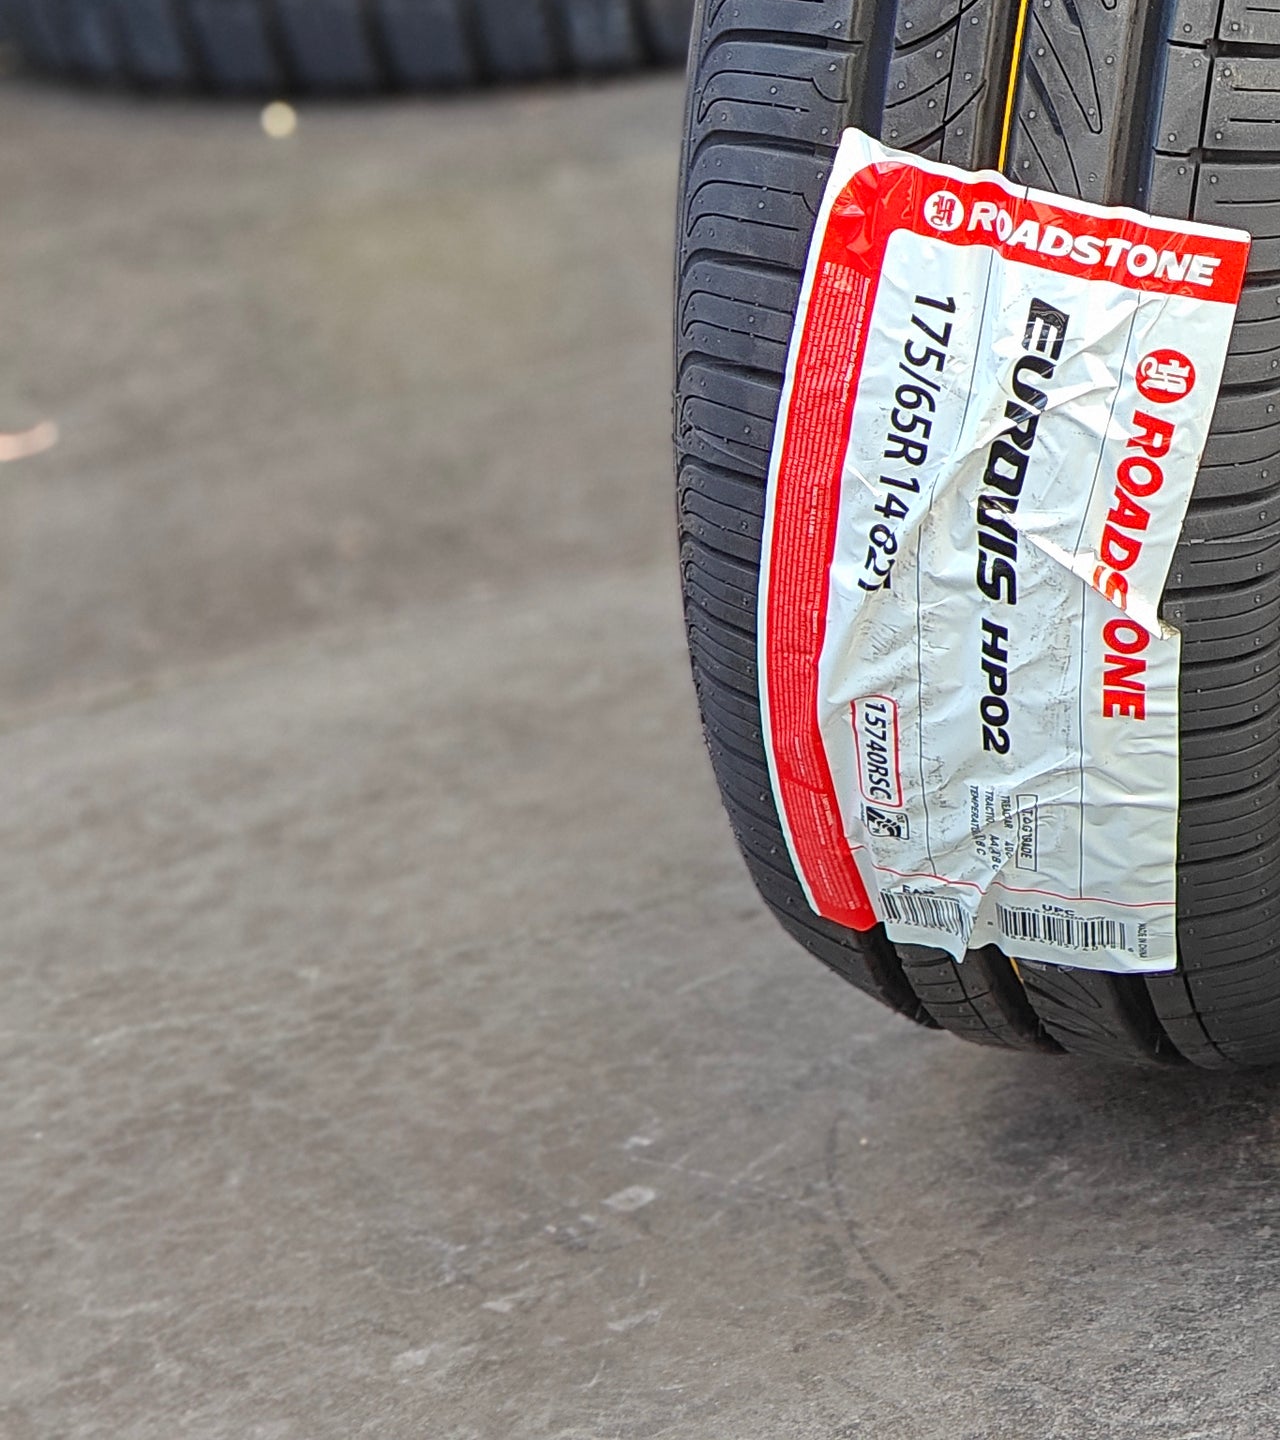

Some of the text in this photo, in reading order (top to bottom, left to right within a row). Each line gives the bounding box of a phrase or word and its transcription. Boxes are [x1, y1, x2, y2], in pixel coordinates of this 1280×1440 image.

[967, 201, 1222, 287] ROADSTONE
[976, 297, 1070, 755] EUROVIS HP02
[1092, 409, 1176, 721] ROADSONE
[865, 702, 892, 800] 15740RSC
